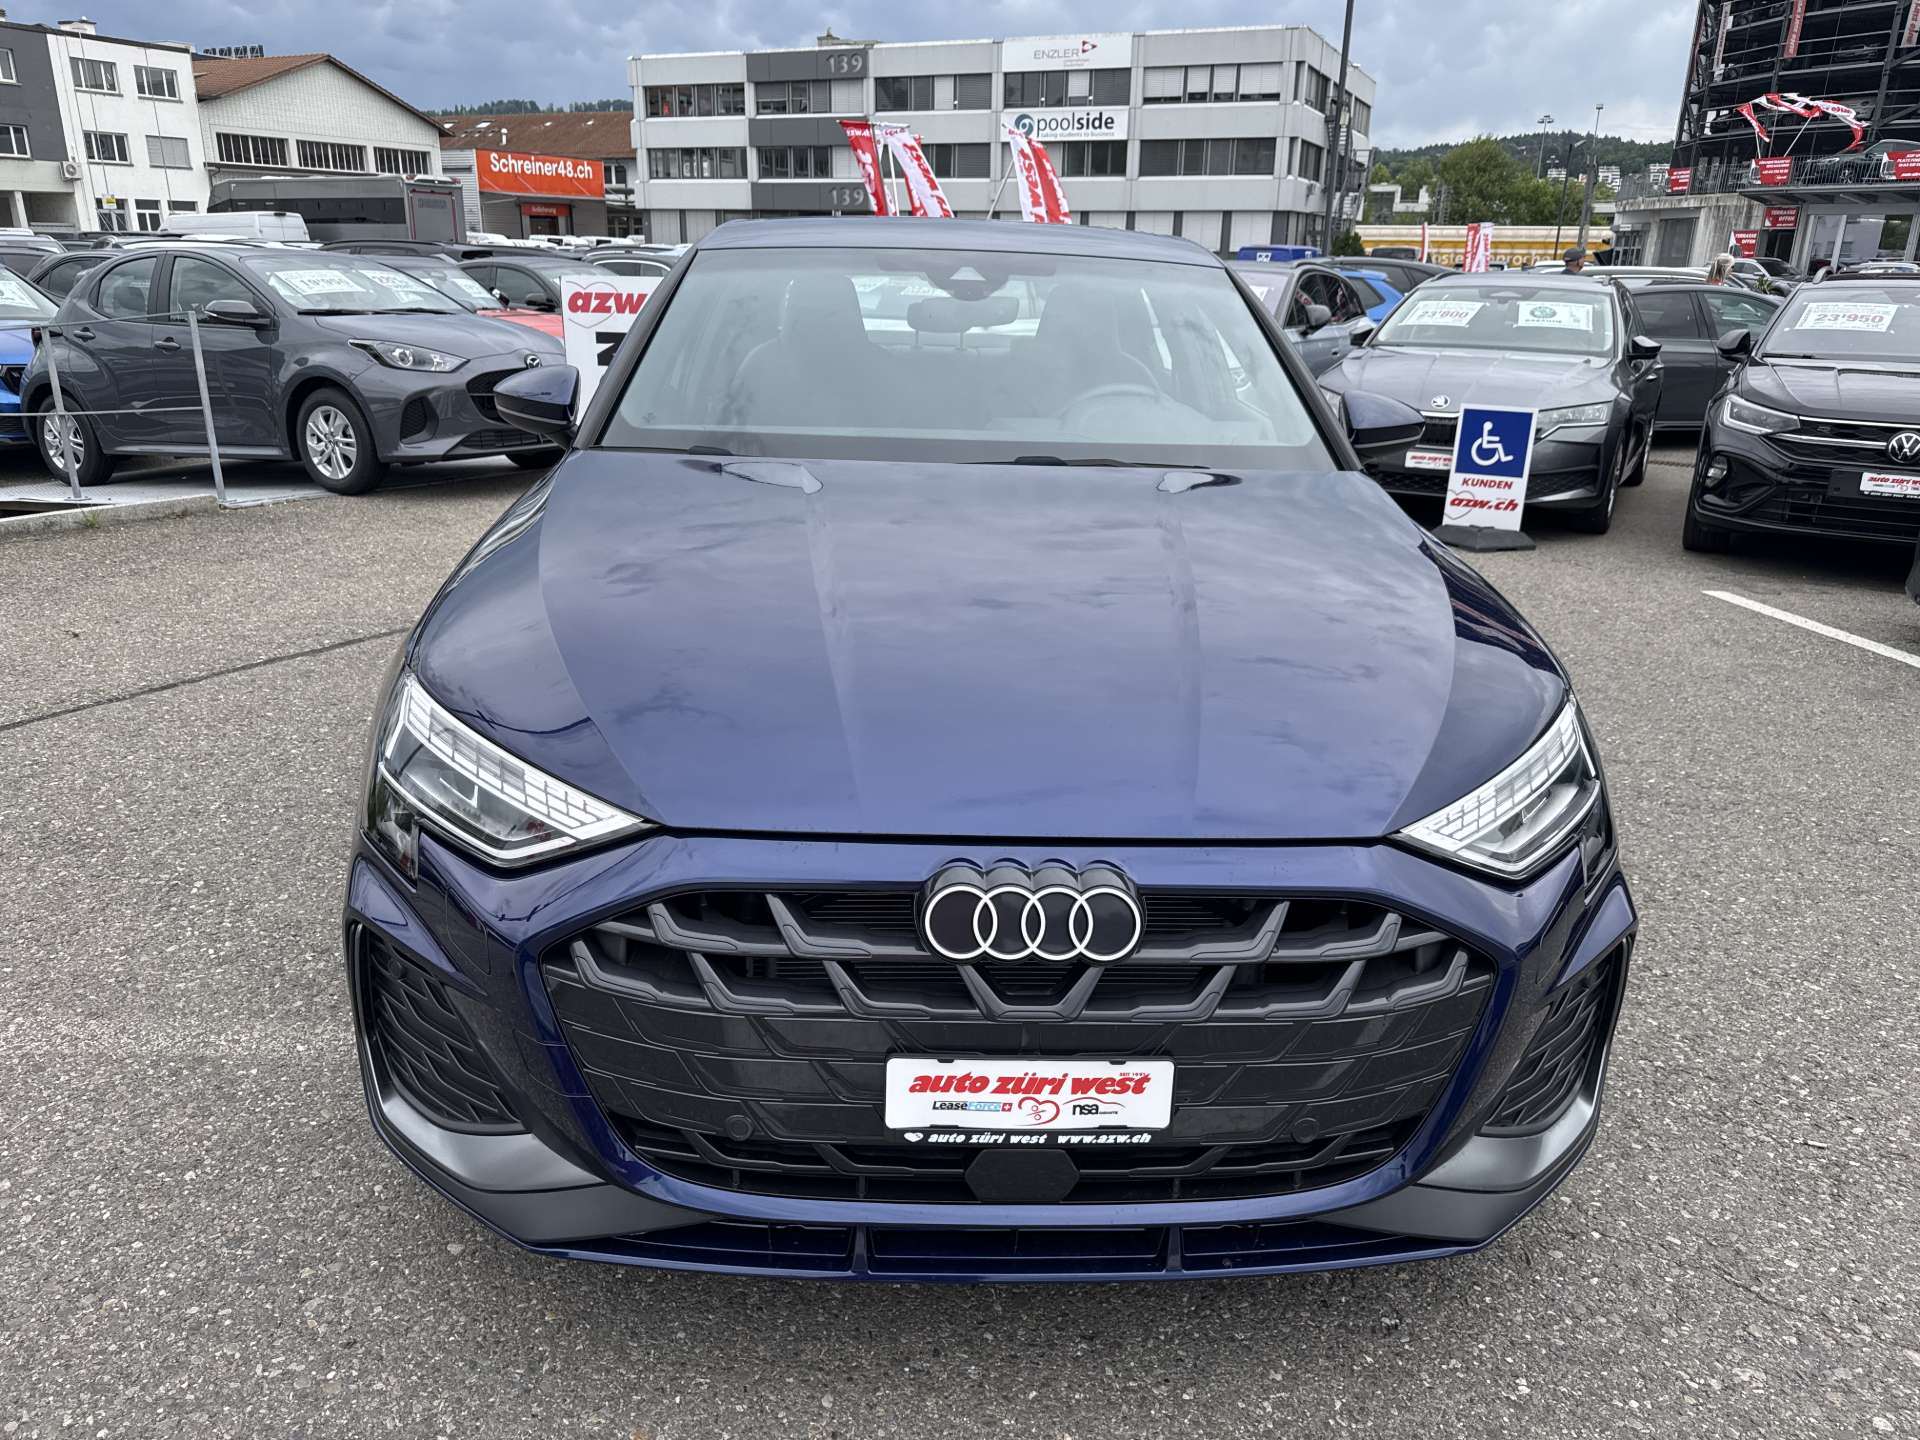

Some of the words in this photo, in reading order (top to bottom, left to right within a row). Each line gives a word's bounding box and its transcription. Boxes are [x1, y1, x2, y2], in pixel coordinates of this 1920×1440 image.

[1033, 48, 1079, 59] ENZLER
[827, 54, 863, 73] 139
[1037, 112, 1115, 138] poolside
[489, 152, 593, 180] Schreiner48.ch
[830, 187, 864, 206] 139
[1815, 313, 1885, 324] 23'950
[1461, 478, 1514, 490] KUNDEN
[1450, 498, 1519, 512] azw.ch
[909, 1072, 990, 1094] auto
[991, 1072, 1069, 1095] züri
[1071, 1073, 1152, 1095] west
[932, 1100, 1001, 1112] LeaseForce
[1072, 1103, 1099, 1115] nsa
[927, 1132, 966, 1144] auto
[969, 1132, 1007, 1145] züri
[1009, 1133, 1048, 1145] west
[1056, 1132, 1152, 1145] www.azw.ch
